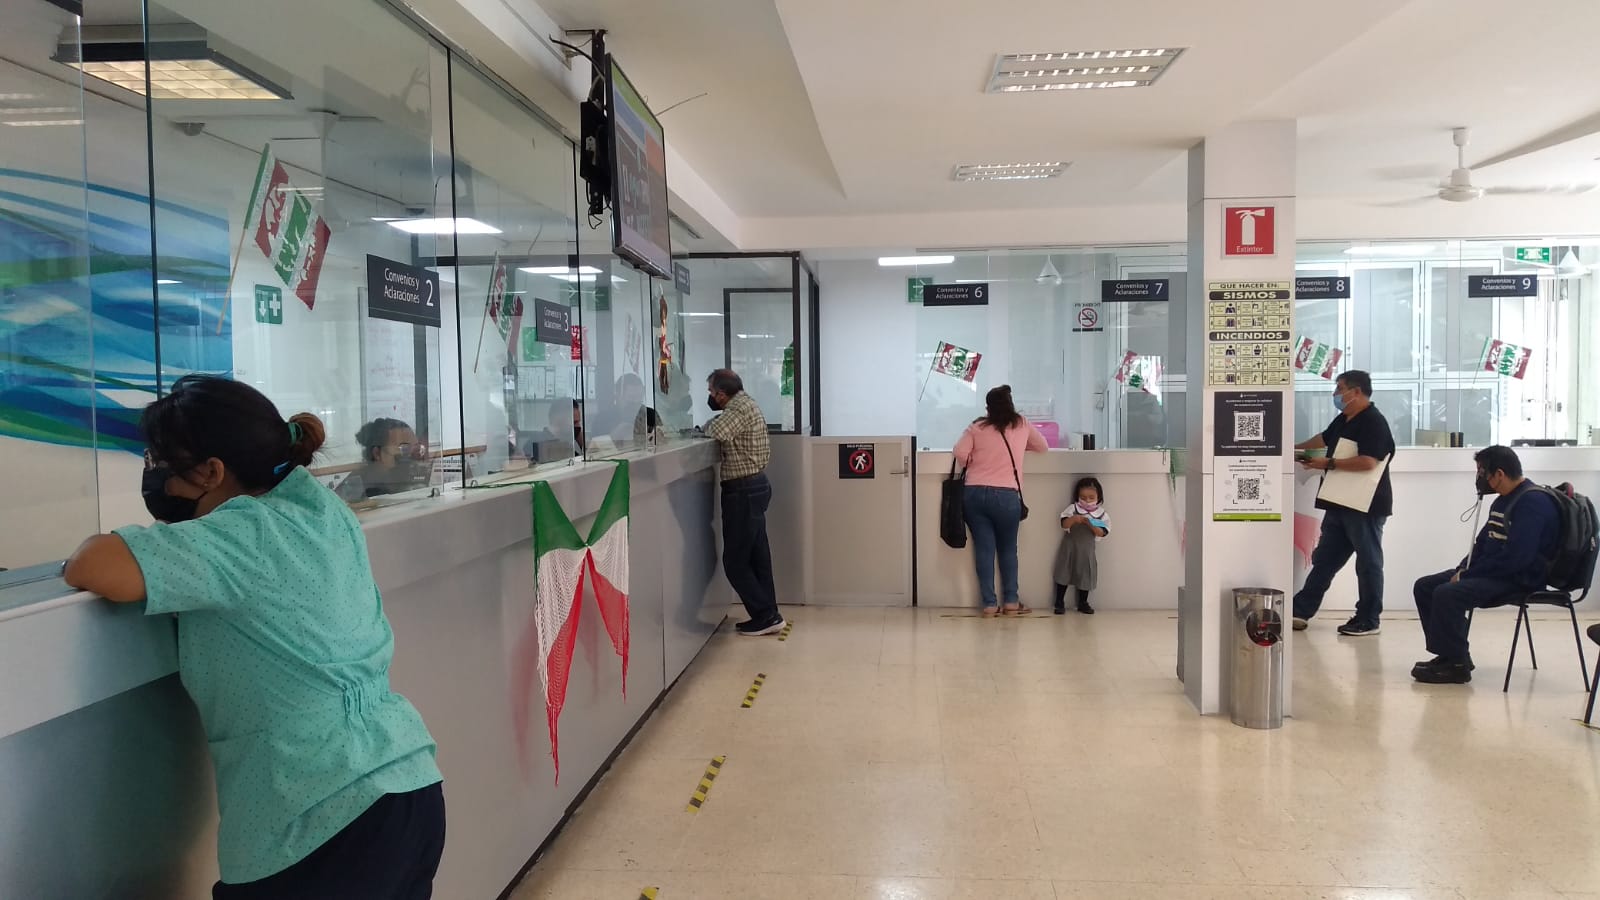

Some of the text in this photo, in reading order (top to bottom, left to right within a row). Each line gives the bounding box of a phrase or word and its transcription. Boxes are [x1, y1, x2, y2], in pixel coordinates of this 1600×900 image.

[1236, 245, 1264, 253] Extintor
[384, 267, 420, 291] Convenios y
[1336, 279, 1345, 292] 8
[1522, 277, 1531, 290] 9
[383, 285, 420, 304] Aclaraciones
[425, 279, 434, 307] 2
[974, 286, 983, 298] 6
[1155, 282, 1163, 295] 7
[1223, 291, 1277, 299] SISMOS
[564, 312, 569, 332] 3
[1216, 332, 1283, 340] INCENDIOS
